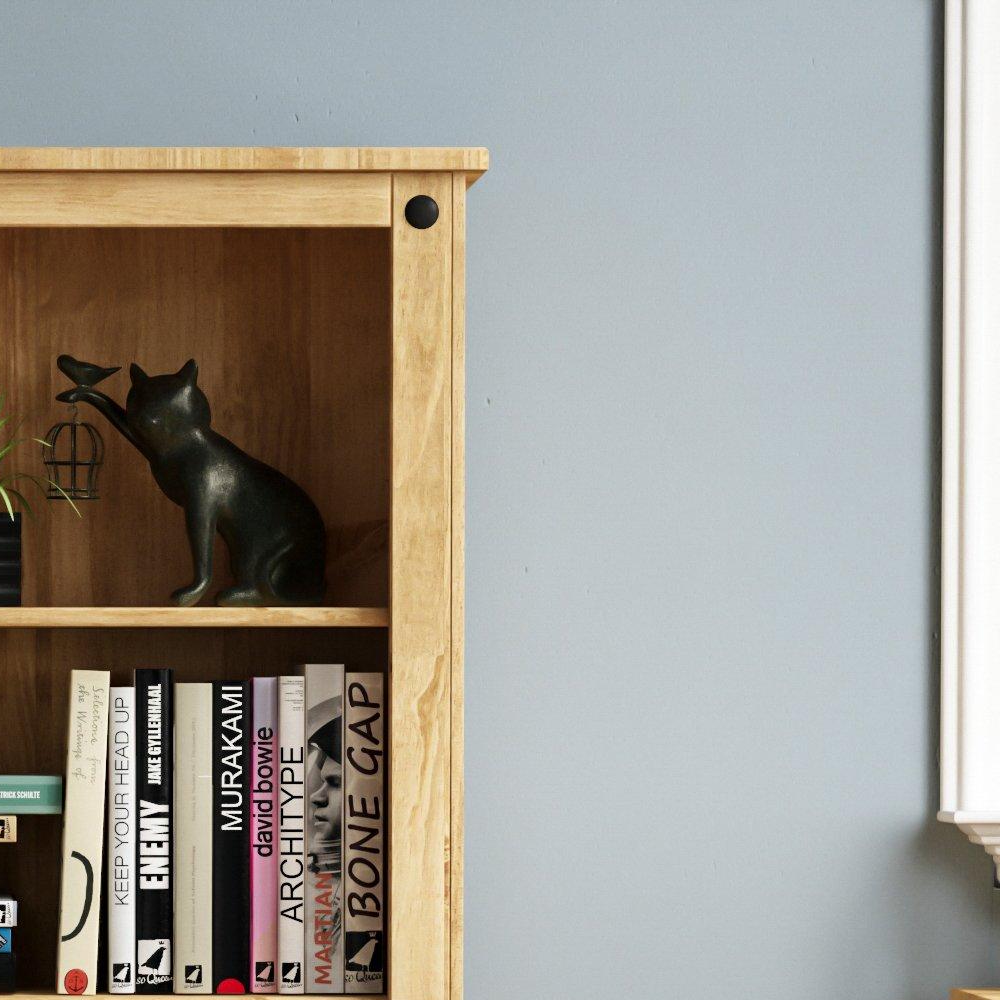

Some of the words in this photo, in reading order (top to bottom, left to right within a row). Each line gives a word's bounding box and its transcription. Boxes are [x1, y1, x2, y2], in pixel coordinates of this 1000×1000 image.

[115, 697, 129, 724] UP
[147, 684, 162, 756] GYLLENHAAL
[347, 683, 380, 776] GAP
[115, 731, 129, 786] HEAD
[147, 758, 161, 785] JAKE
[222, 685, 242, 831] MURAKAMI
[253, 727, 273, 792] bowie
[17, 790, 40, 799] SCHULTE
[115, 792, 129, 846] YOUR
[140, 800, 169, 890] ENEMY
[253, 800, 273, 857] david
[280, 747, 304, 923] ARCHITYPE
[348, 795, 380, 918] BONE
[114, 855, 129, 906] KEEP
[314, 873, 333, 985] MARTIAN
